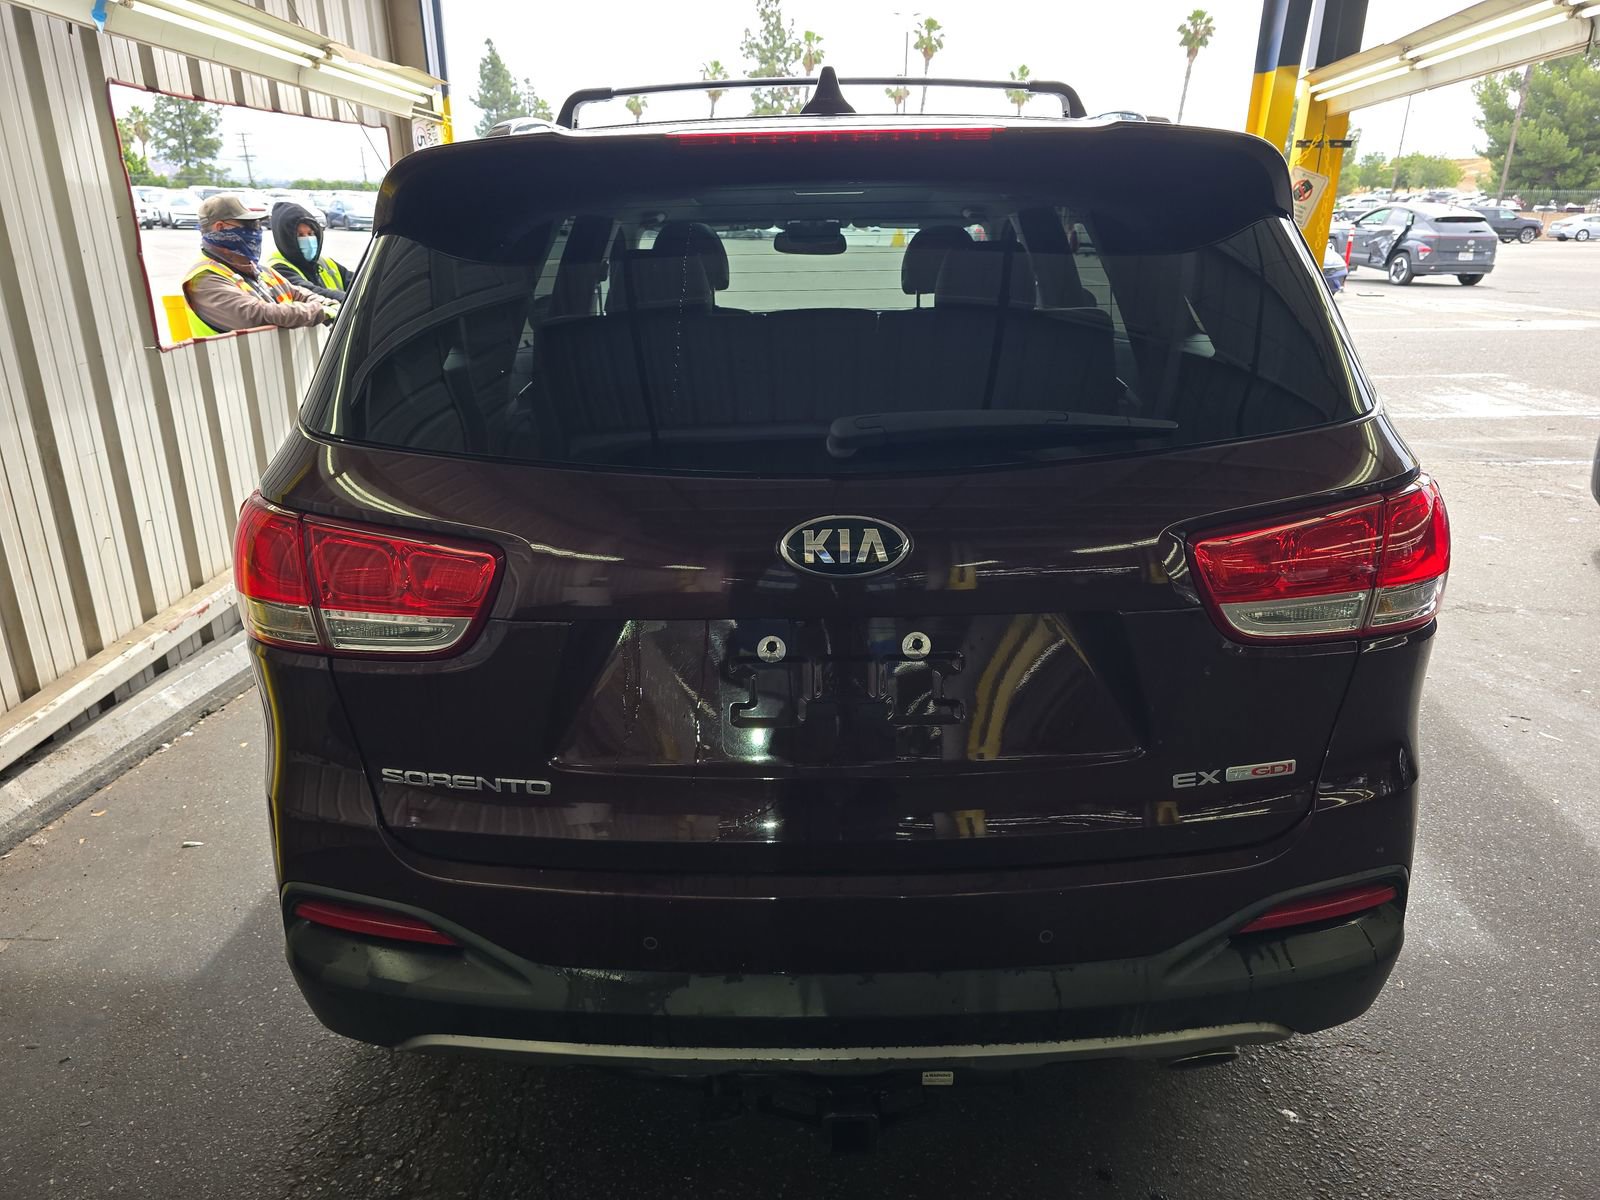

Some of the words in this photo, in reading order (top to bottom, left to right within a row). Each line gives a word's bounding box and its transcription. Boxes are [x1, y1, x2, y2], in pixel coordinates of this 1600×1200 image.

[416, 135, 427, 147] 5
[802, 528, 889, 564] KIA
[381, 768, 551, 796] SORENTO
[1172, 769, 1221, 789] EX
